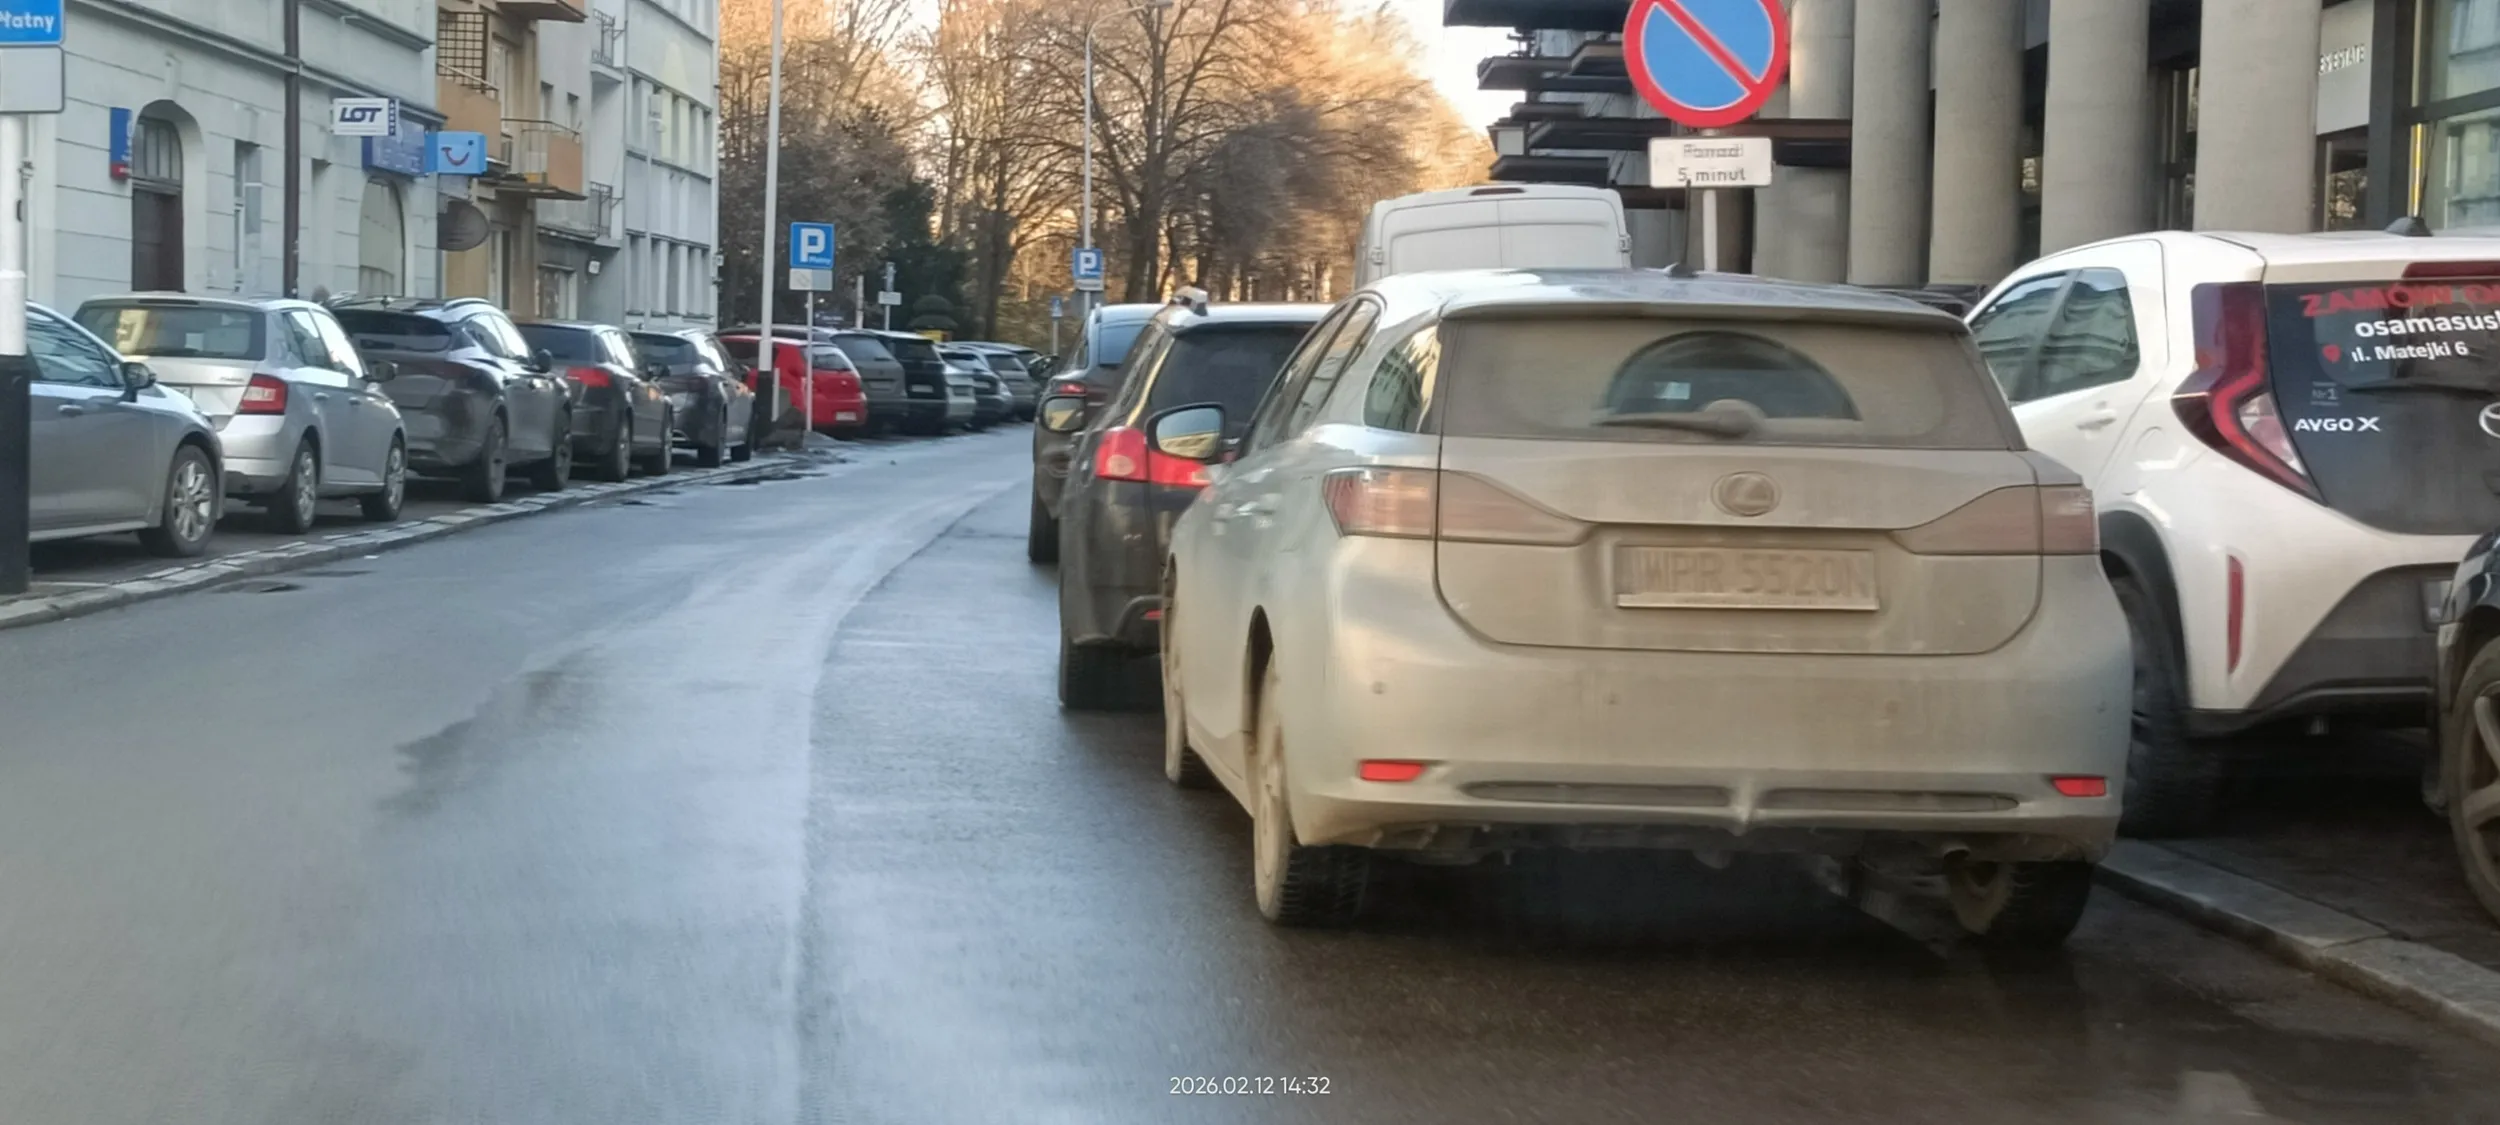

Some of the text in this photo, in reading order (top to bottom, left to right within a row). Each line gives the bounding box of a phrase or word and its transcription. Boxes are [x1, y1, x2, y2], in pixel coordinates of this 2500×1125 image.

[339, 107, 382, 122] LOT
[1677, 166, 1746, 182] 5 minut
[801, 228, 825, 263] P
[1080, 252, 1097, 275] P
[2374, 341, 2451, 360] Matejki
[2455, 341, 2469, 356] 6
[2294, 416, 2381, 432] AYGO X
